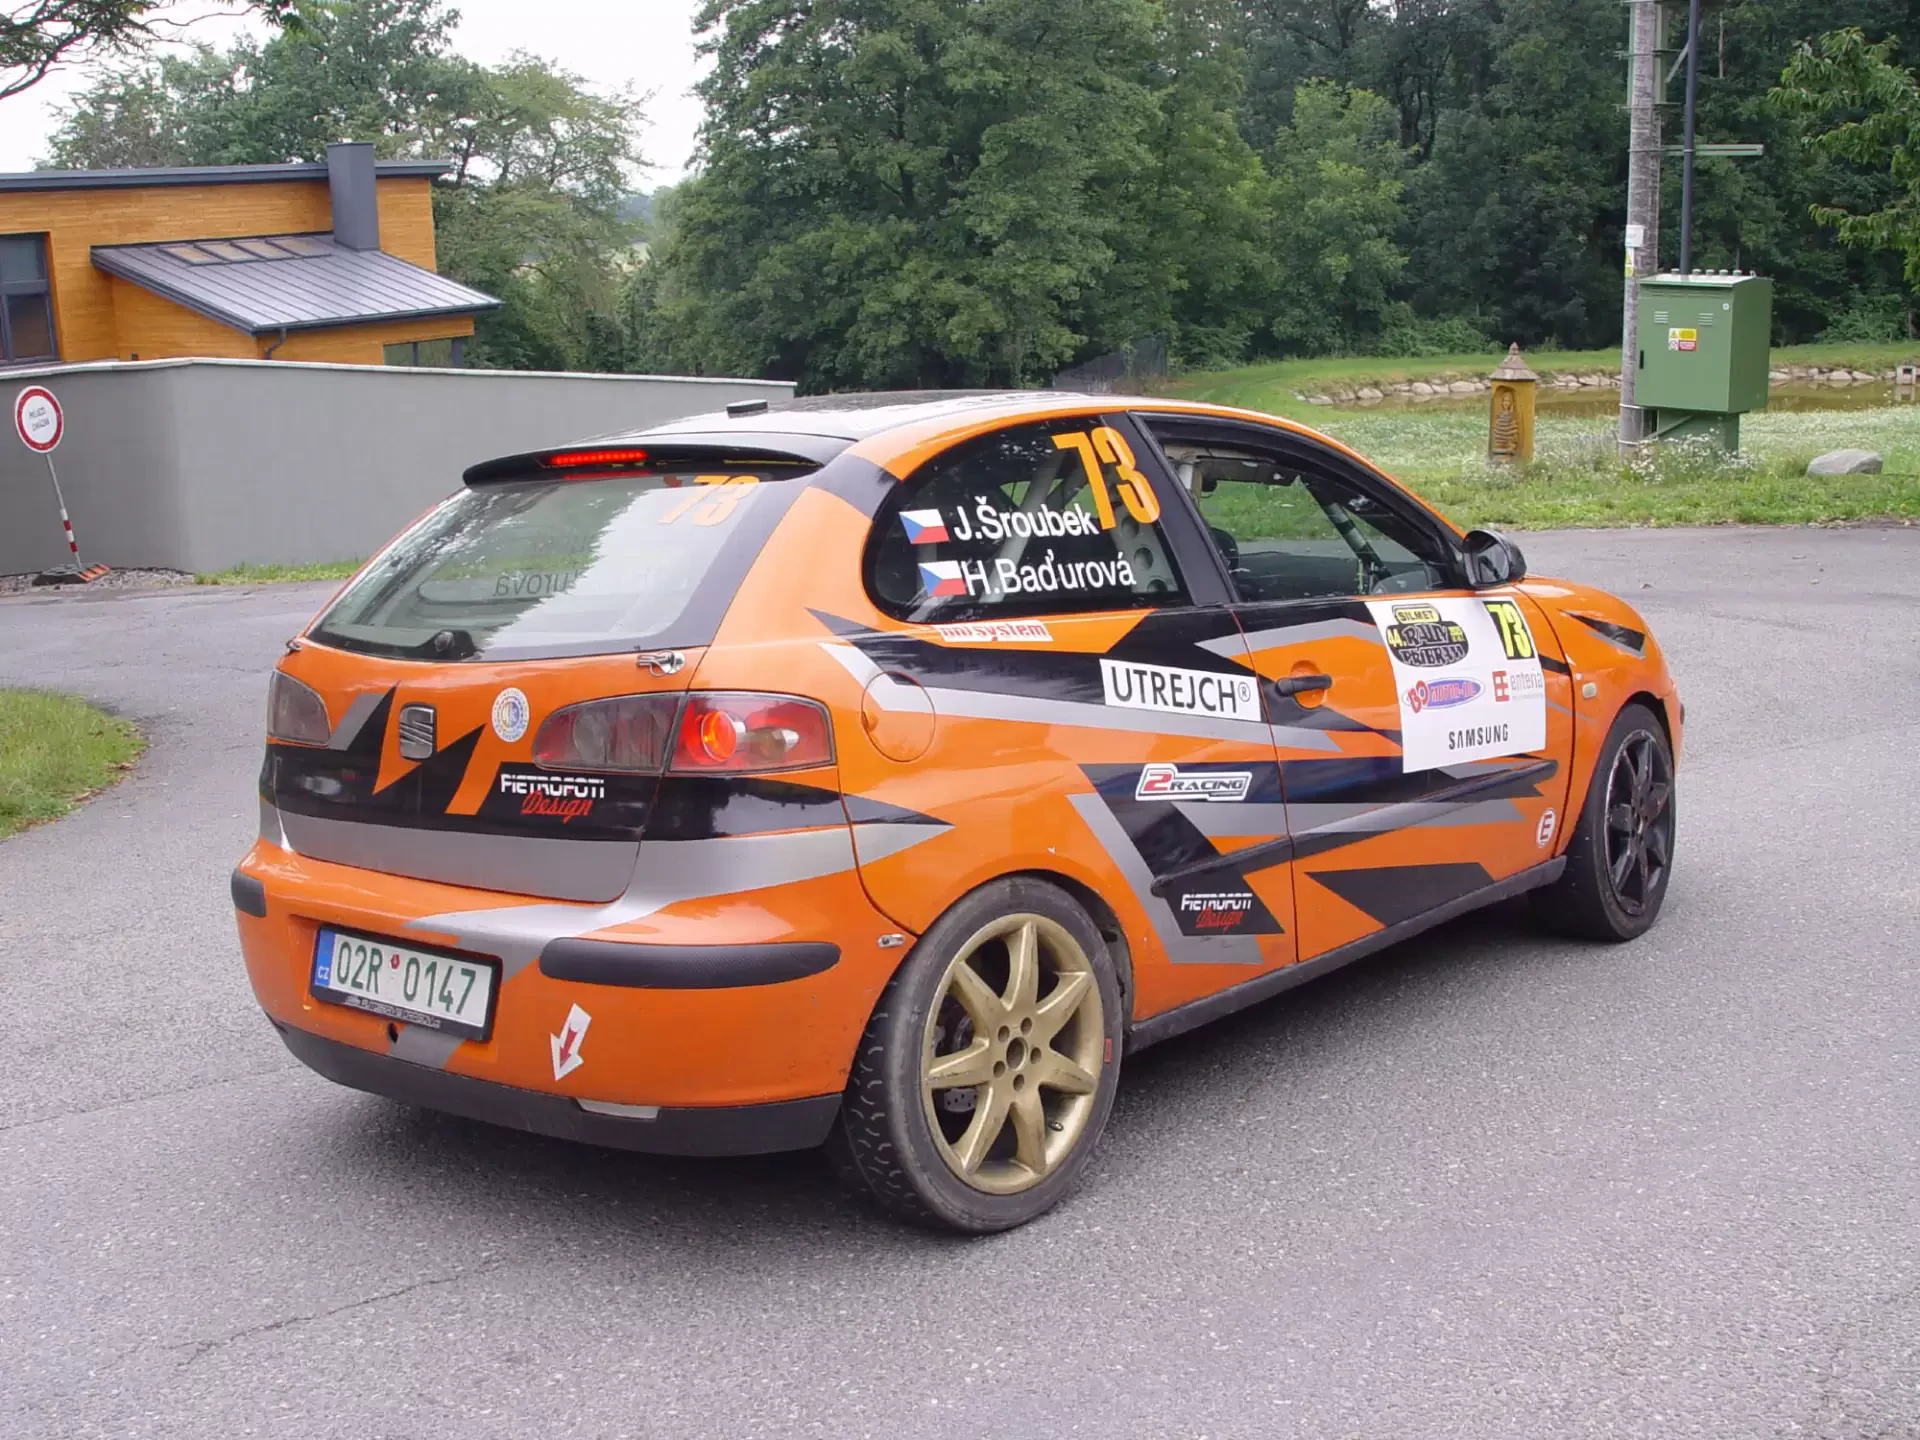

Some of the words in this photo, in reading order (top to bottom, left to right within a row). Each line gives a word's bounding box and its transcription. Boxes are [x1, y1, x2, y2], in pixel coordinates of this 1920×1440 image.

[1051, 426, 1161, 530] 73
[658, 475, 760, 526] 73
[954, 496, 1100, 541] J.Šroubek
[961, 550, 1136, 596] H.Baďurová
[1398, 610, 1435, 621] SILMET
[1486, 604, 1534, 660] 73
[1402, 624, 1448, 647] RALLY
[1510, 668, 1543, 691] enteria
[1449, 724, 1509, 750] SAMSUNG
[520, 791, 594, 824] Design
[1196, 908, 1243, 932] Design
[317, 966, 330, 980] CZ
[337, 941, 383, 995] 02R
[404, 957, 477, 1015] 0147
